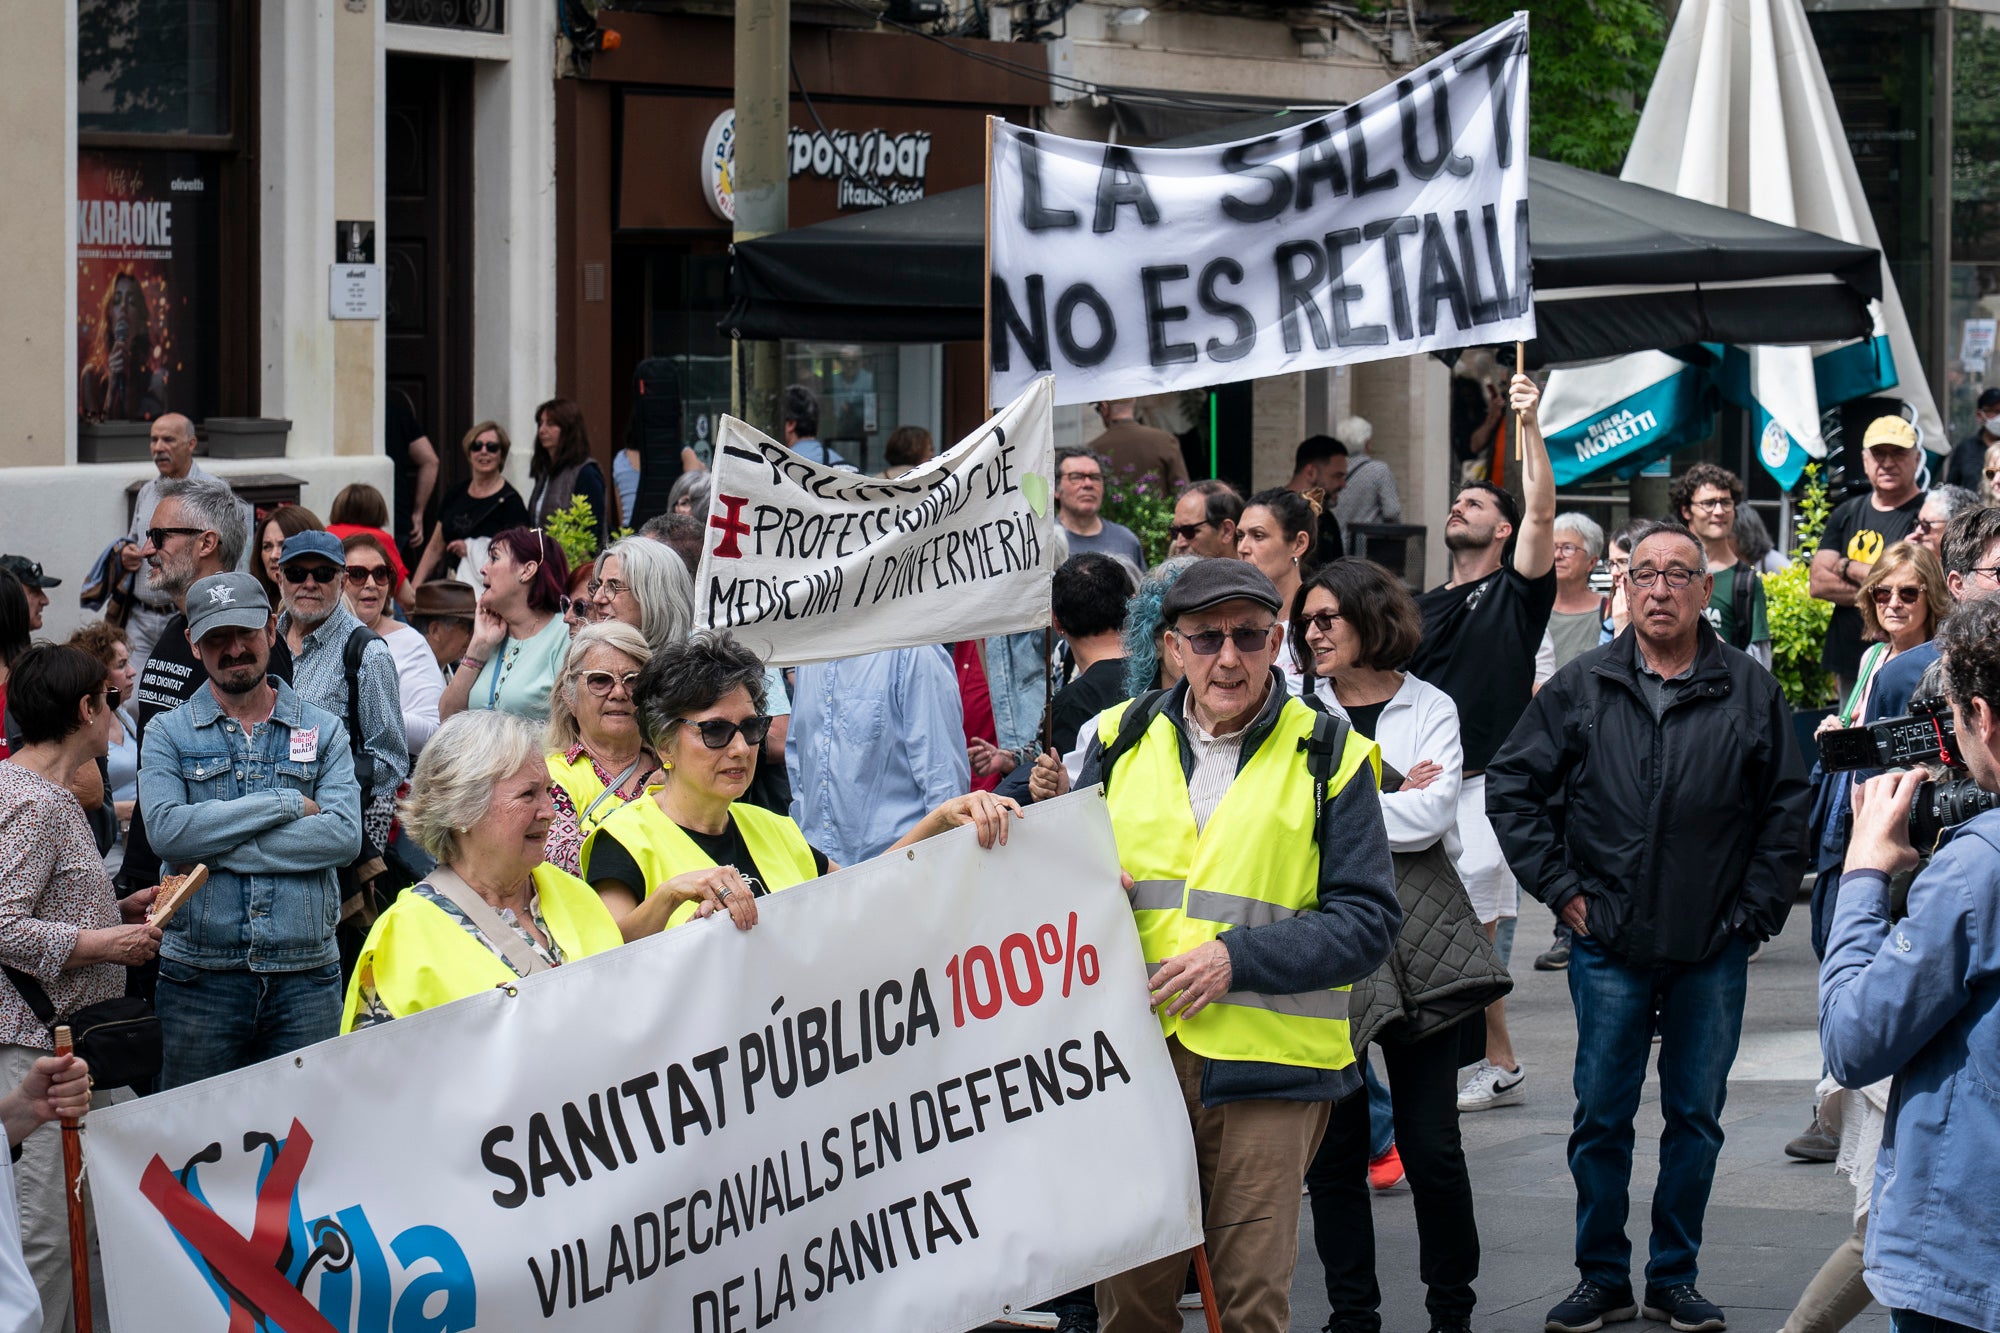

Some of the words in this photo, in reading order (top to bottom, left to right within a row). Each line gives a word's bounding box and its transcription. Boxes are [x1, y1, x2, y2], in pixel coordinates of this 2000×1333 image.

[788, 128, 873, 178] ports
[874, 129, 932, 178] bar
[1017, 132, 1160, 233] LA
[1221, 31, 1528, 223] SALUT
[77, 200, 172, 246] KARAOKE
[992, 273, 1117, 372] NO
[1141, 257, 1257, 366] ES
[1574, 409, 1658, 463] MORETTI
[1588, 408, 1635, 438] BIRRA
[986, 446, 1019, 500] DE
[480, 1046, 729, 1209] SANITAT
[739, 967, 941, 1116] PÚBLICA
[946, 911, 1101, 1029] 100%
[528, 1127, 844, 1319] VILADECAVALLS
[851, 1102, 902, 1179] EN
[910, 1030, 1132, 1155] DEFENSA
[692, 1275, 746, 1333] DE
[754, 1254, 796, 1330] LA
[803, 1177, 980, 1302] SANITAT
